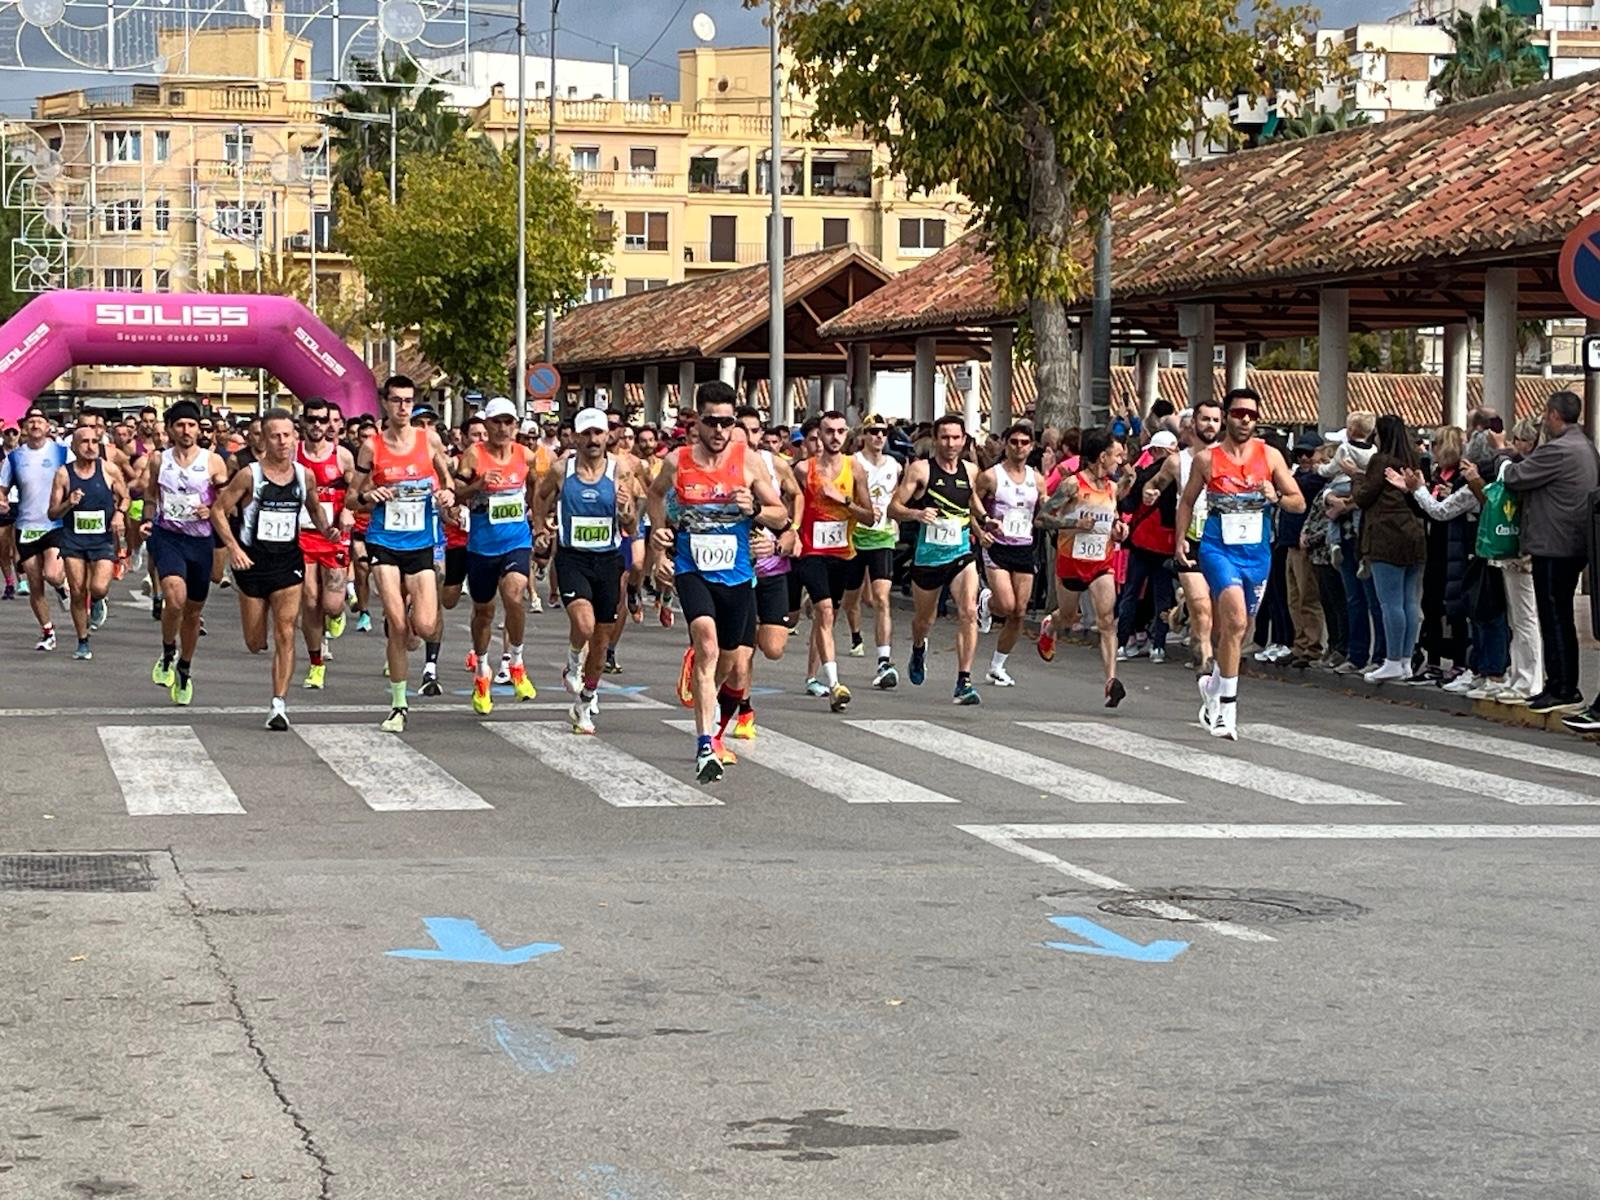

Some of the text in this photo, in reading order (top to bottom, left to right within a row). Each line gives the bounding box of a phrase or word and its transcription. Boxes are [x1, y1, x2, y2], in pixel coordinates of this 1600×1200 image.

[96, 304, 249, 326] SOLISS
[116, 332, 162, 343] Seguros
[167, 333, 199, 342] desde
[0, 322, 50, 373] SOLISS
[294, 326, 347, 377] SOLISS
[392, 512, 417, 526] 211
[265, 522, 290, 539] 212
[574, 525, 610, 542] 4040
[822, 530, 843, 545] 153
[1238, 525, 1248, 539] 2
[696, 547, 734, 566] 1090
[1079, 541, 1103, 556] 302
